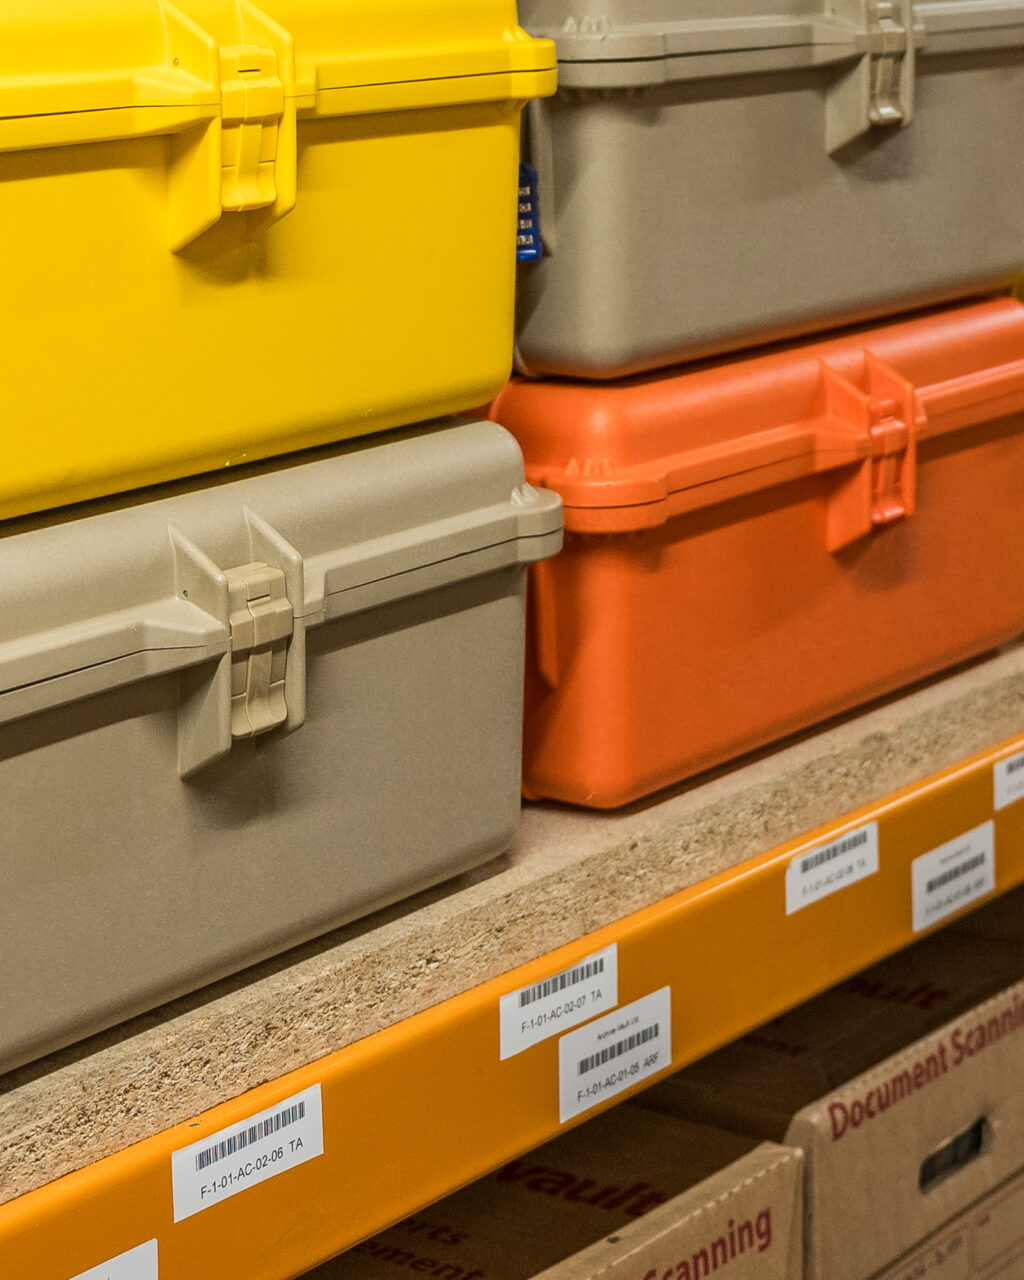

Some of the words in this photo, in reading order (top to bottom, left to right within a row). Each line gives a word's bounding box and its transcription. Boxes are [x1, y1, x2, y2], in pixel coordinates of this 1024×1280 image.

[521, 995, 586, 1033] F-1-01-AC-02-07
[591, 988, 603, 1001] TA
[828, 1042, 949, 1142] Document
[200, 1146, 284, 1199] F-1-01-AC-02-06
[289, 1137, 304, 1153] TA
